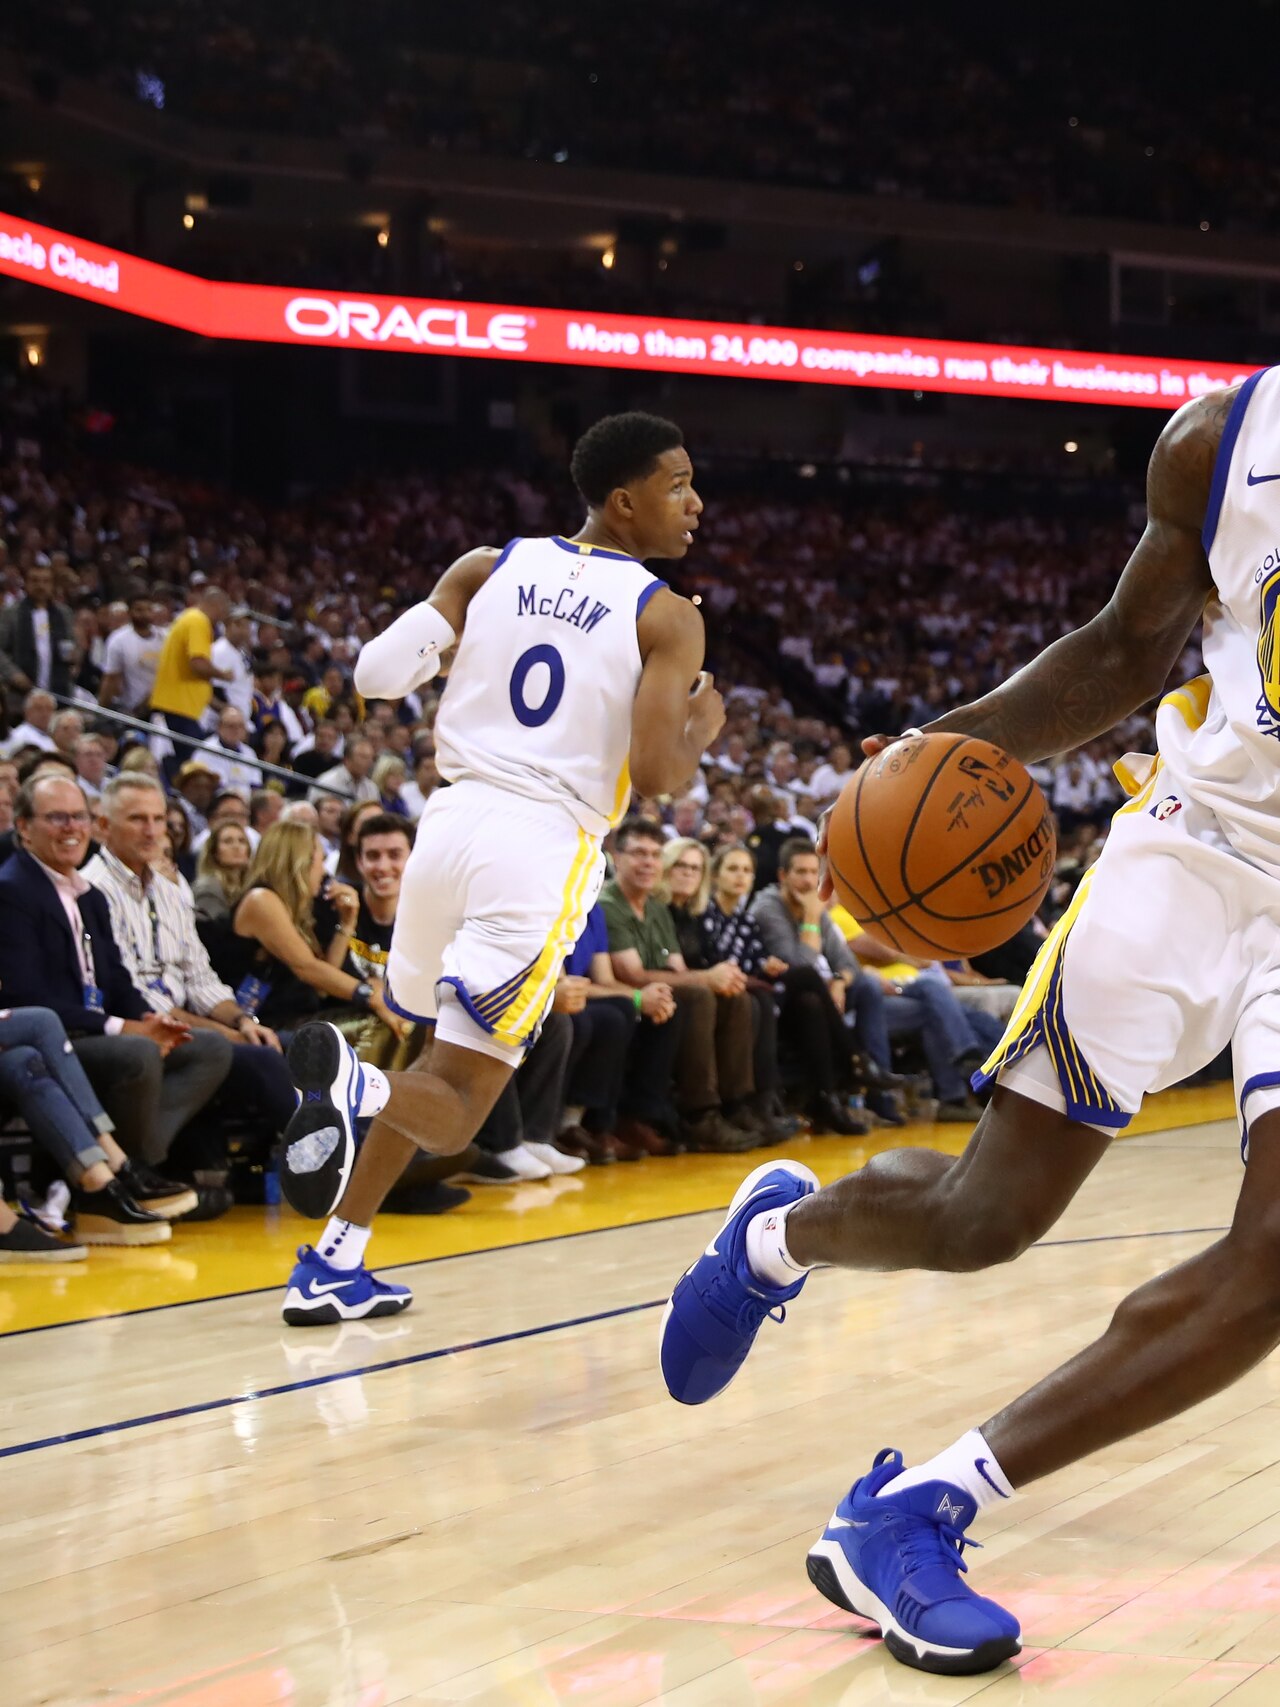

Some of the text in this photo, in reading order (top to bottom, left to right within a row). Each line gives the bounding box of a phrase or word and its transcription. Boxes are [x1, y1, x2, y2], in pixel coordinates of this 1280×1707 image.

[50, 243, 119, 293] Cloud
[285, 297, 529, 352] ORACLE
[566, 322, 640, 355] More
[644, 329, 706, 360] than
[710, 334, 798, 367] 24,000
[801, 347, 939, 378] companies
[944, 357, 987, 381] run
[991, 357, 1049, 386] their
[1053, 361, 1158, 394] business
[1160, 369, 1185, 396] in
[517, 584, 612, 634] McCAW
[509, 643, 566, 728] 0
